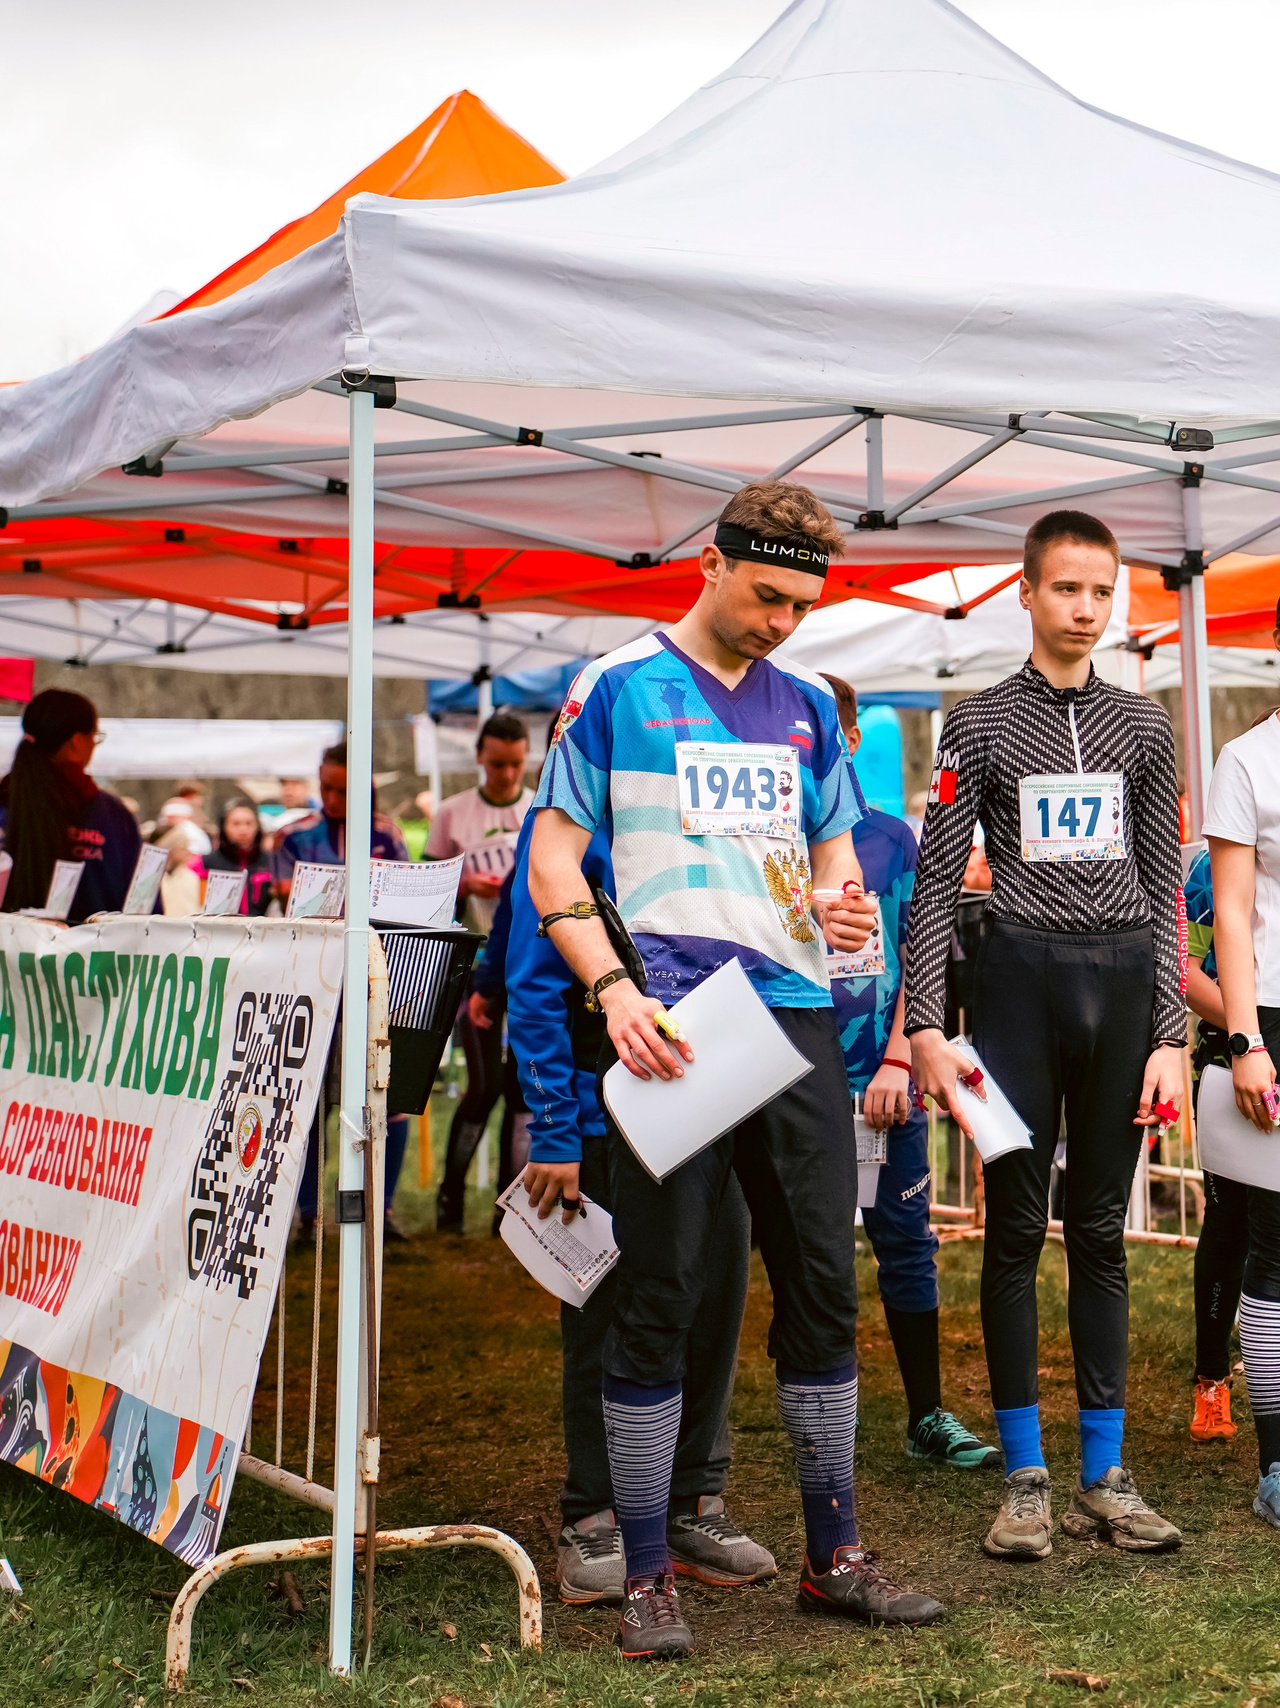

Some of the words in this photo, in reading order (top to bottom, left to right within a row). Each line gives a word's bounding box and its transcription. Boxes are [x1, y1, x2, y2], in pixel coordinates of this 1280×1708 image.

[644, 717, 711, 729] СЕВАСТОПОЛЬ
[685, 765, 777, 811] 1943
[1037, 797, 1101, 838] 147
[18, 950, 231, 1101] ПАСТУХОВА
[0, 1101, 153, 1207] СОРЕВНОВАНИЯ
